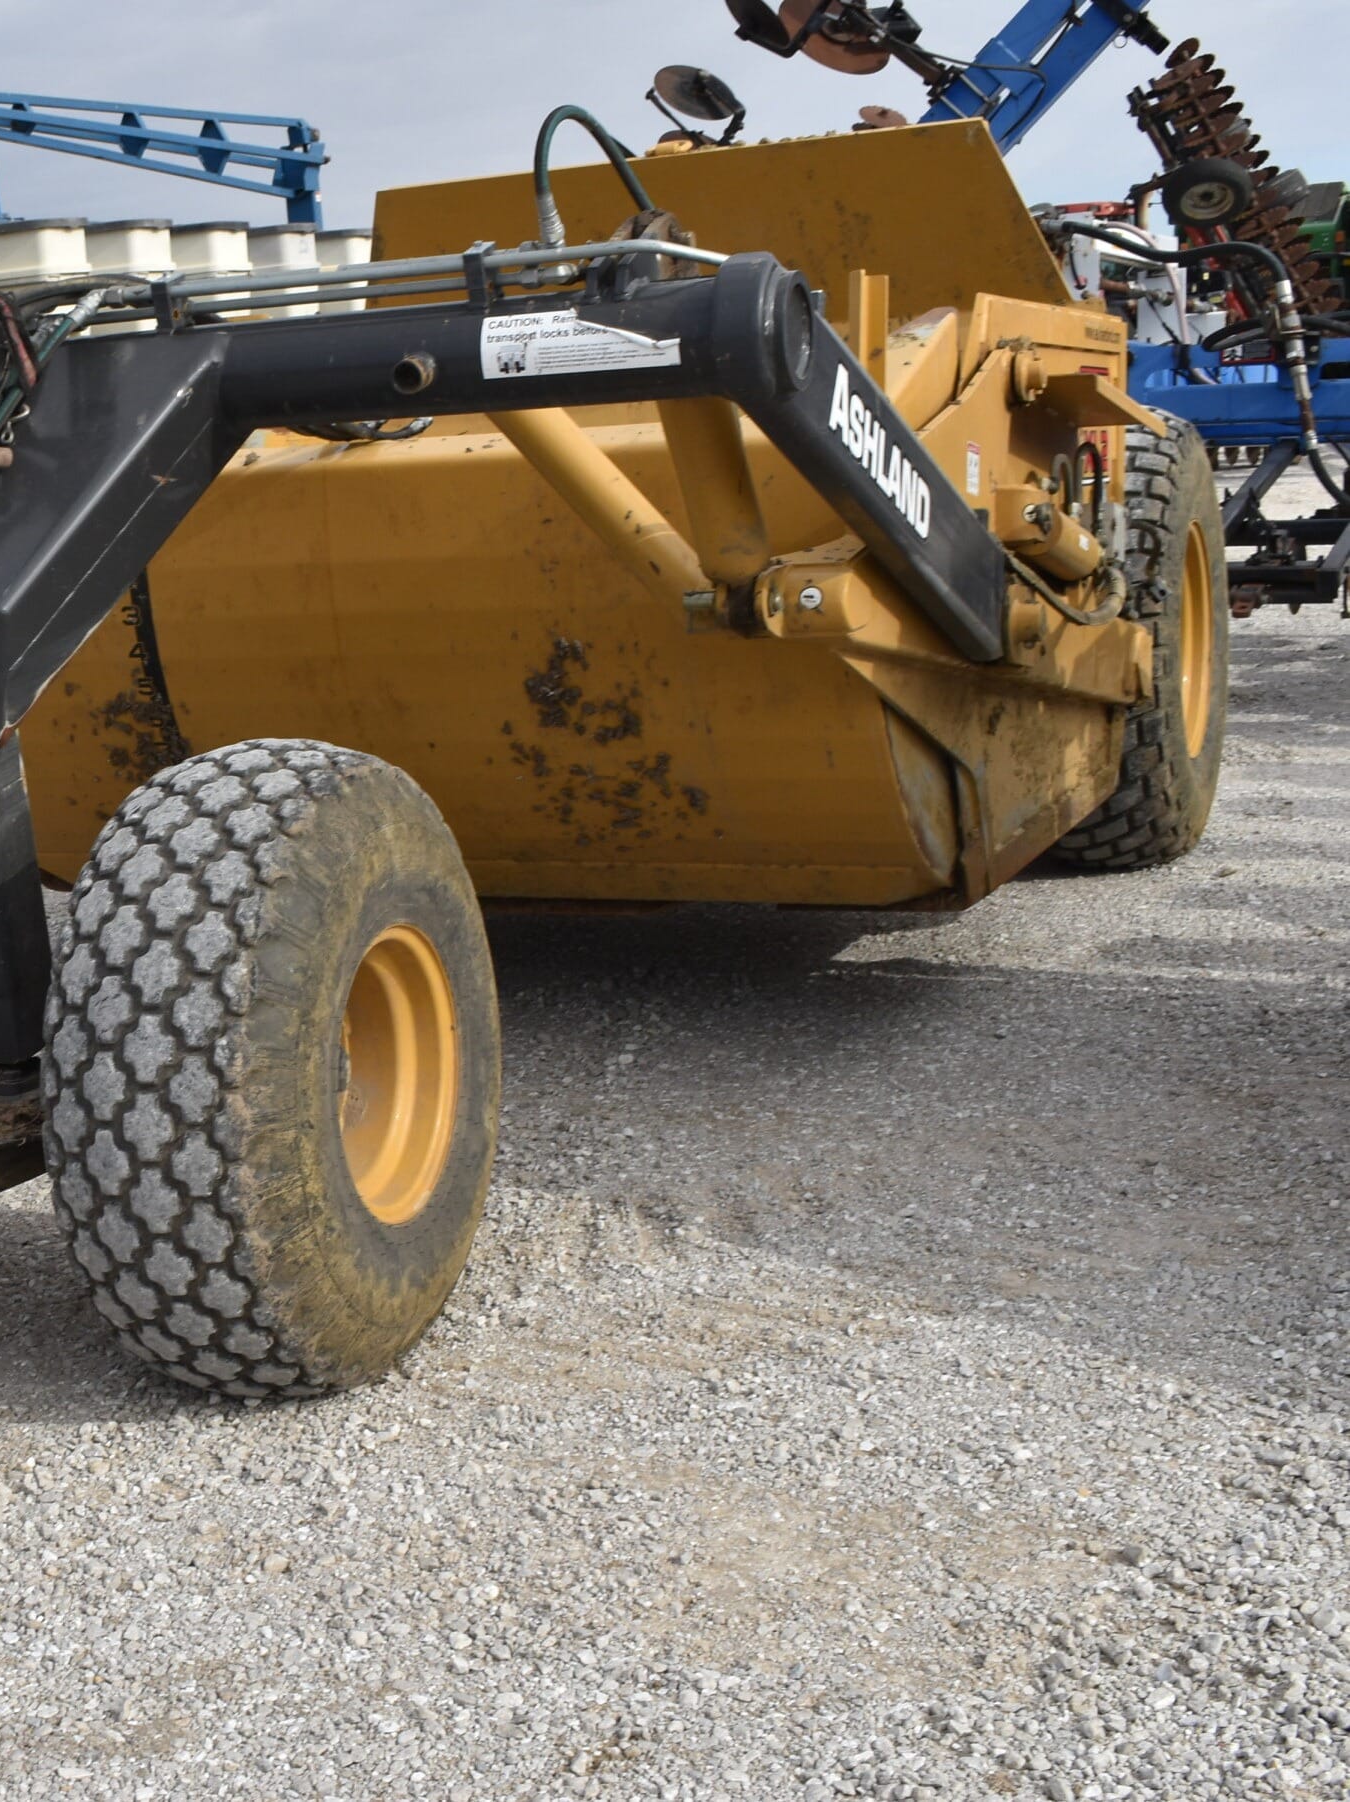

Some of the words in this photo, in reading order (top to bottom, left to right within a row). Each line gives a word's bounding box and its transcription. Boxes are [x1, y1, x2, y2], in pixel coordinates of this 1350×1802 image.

[487, 316, 544, 330] CAUTION:
[552, 314, 578, 324] Rem
[486, 330, 537, 344] transport
[539, 327, 570, 340] locks
[828, 363, 931, 539] ASHLAND
[121, 605, 141, 626] 3
[128, 641, 148, 663] 4
[137, 677, 154, 697] 5
